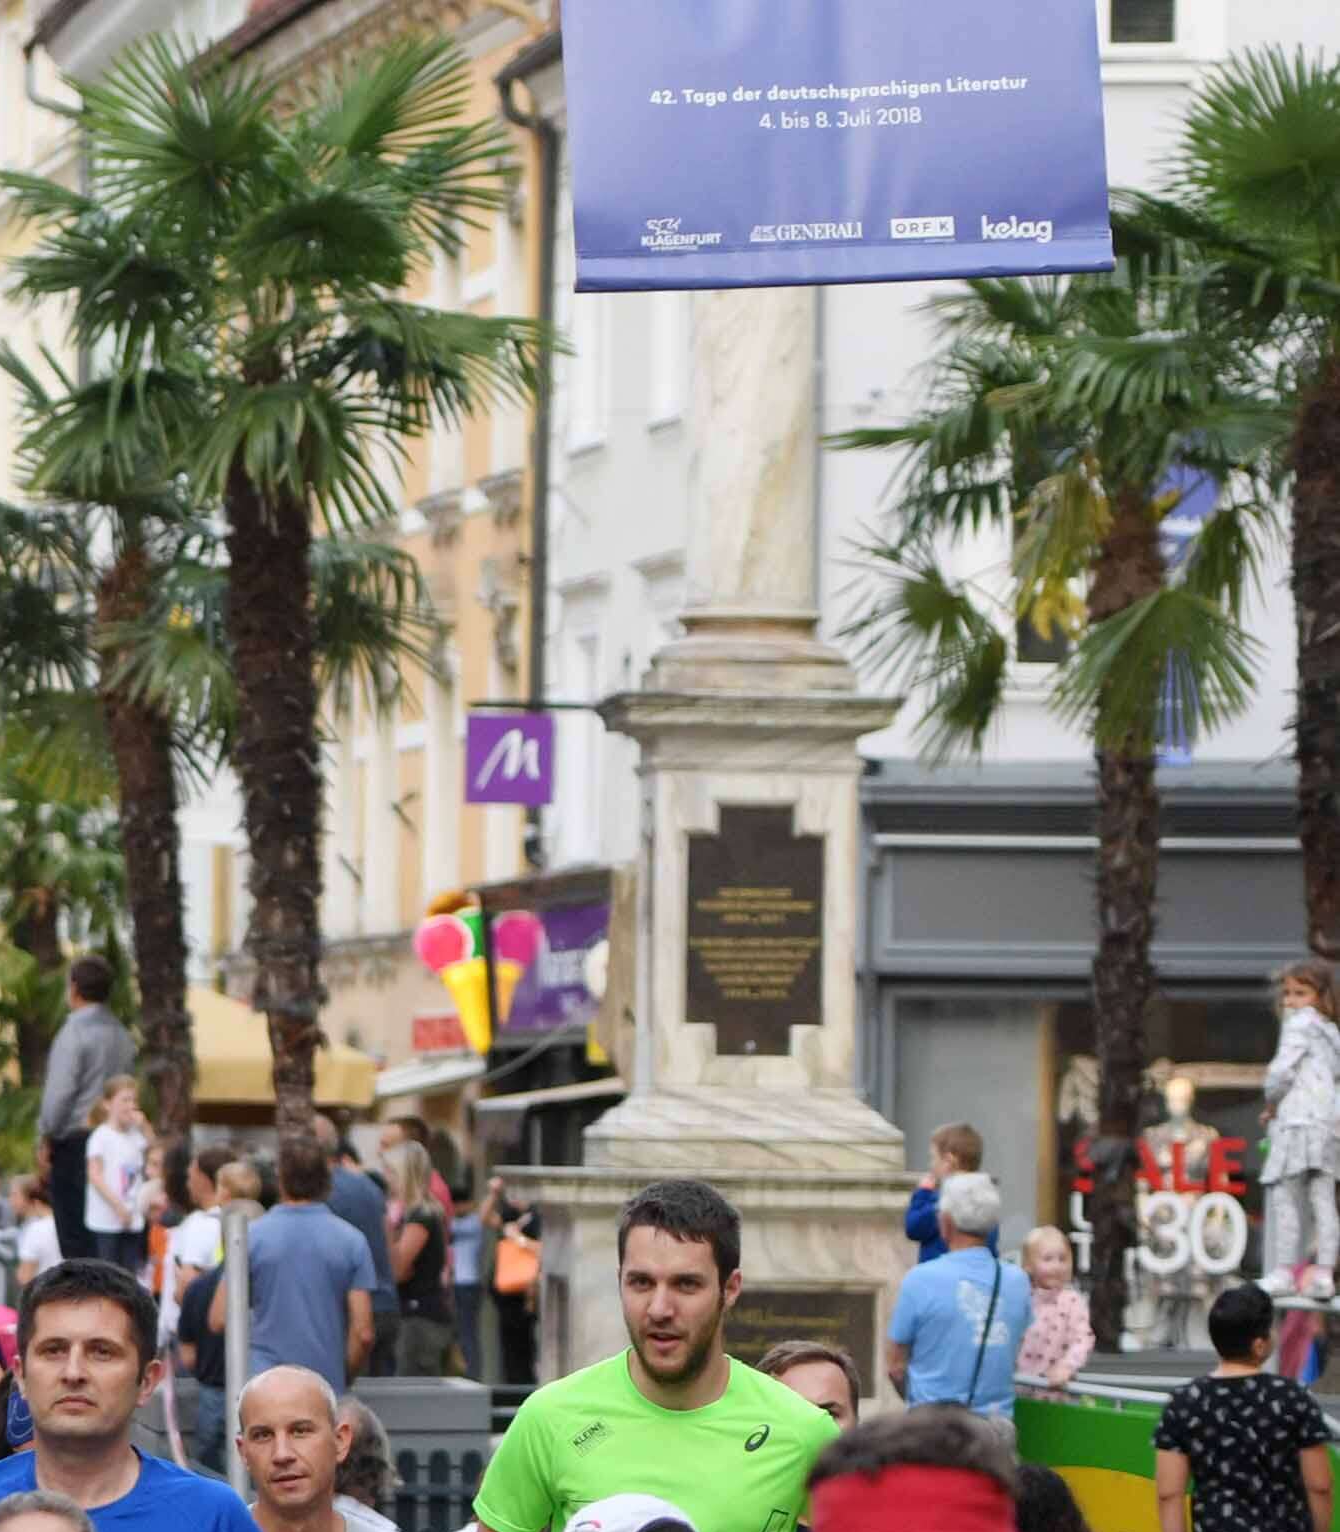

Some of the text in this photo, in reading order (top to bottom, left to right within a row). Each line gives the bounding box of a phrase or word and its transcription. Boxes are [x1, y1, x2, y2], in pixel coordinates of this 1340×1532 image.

[650, 76, 1028, 107] 42. Tage der deutschsprachigen Literatur
[759, 106, 922, 130] 4. bis 8. Juli 2018
[776, 222, 863, 241] GENERALI
[894, 221, 932, 235] ORF
[981, 214, 1053, 243] kelag
[641, 232, 723, 247] KLAGENFURT
